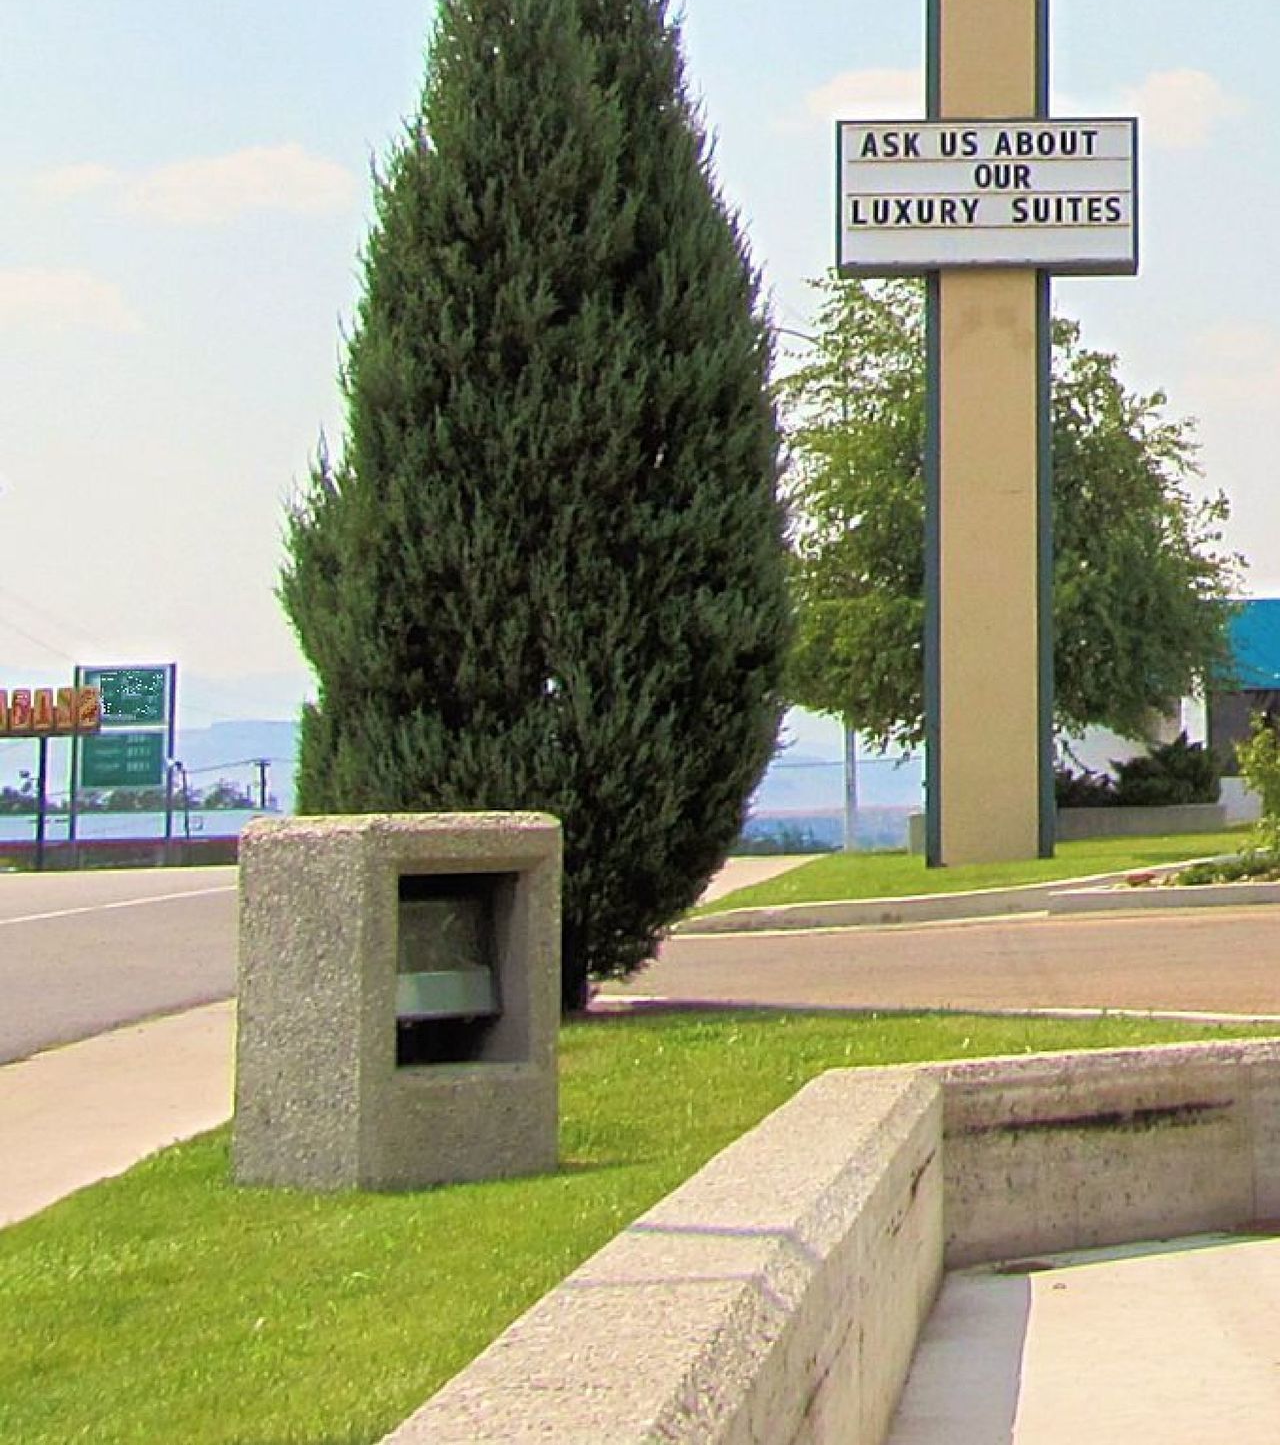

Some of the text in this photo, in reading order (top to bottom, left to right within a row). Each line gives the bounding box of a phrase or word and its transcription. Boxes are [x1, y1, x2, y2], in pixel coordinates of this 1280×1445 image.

[860, 130, 1098, 157] ASK US ABOUT
[974, 164, 1031, 189] OUR
[851, 196, 1121, 224] LUXURY SUITES
